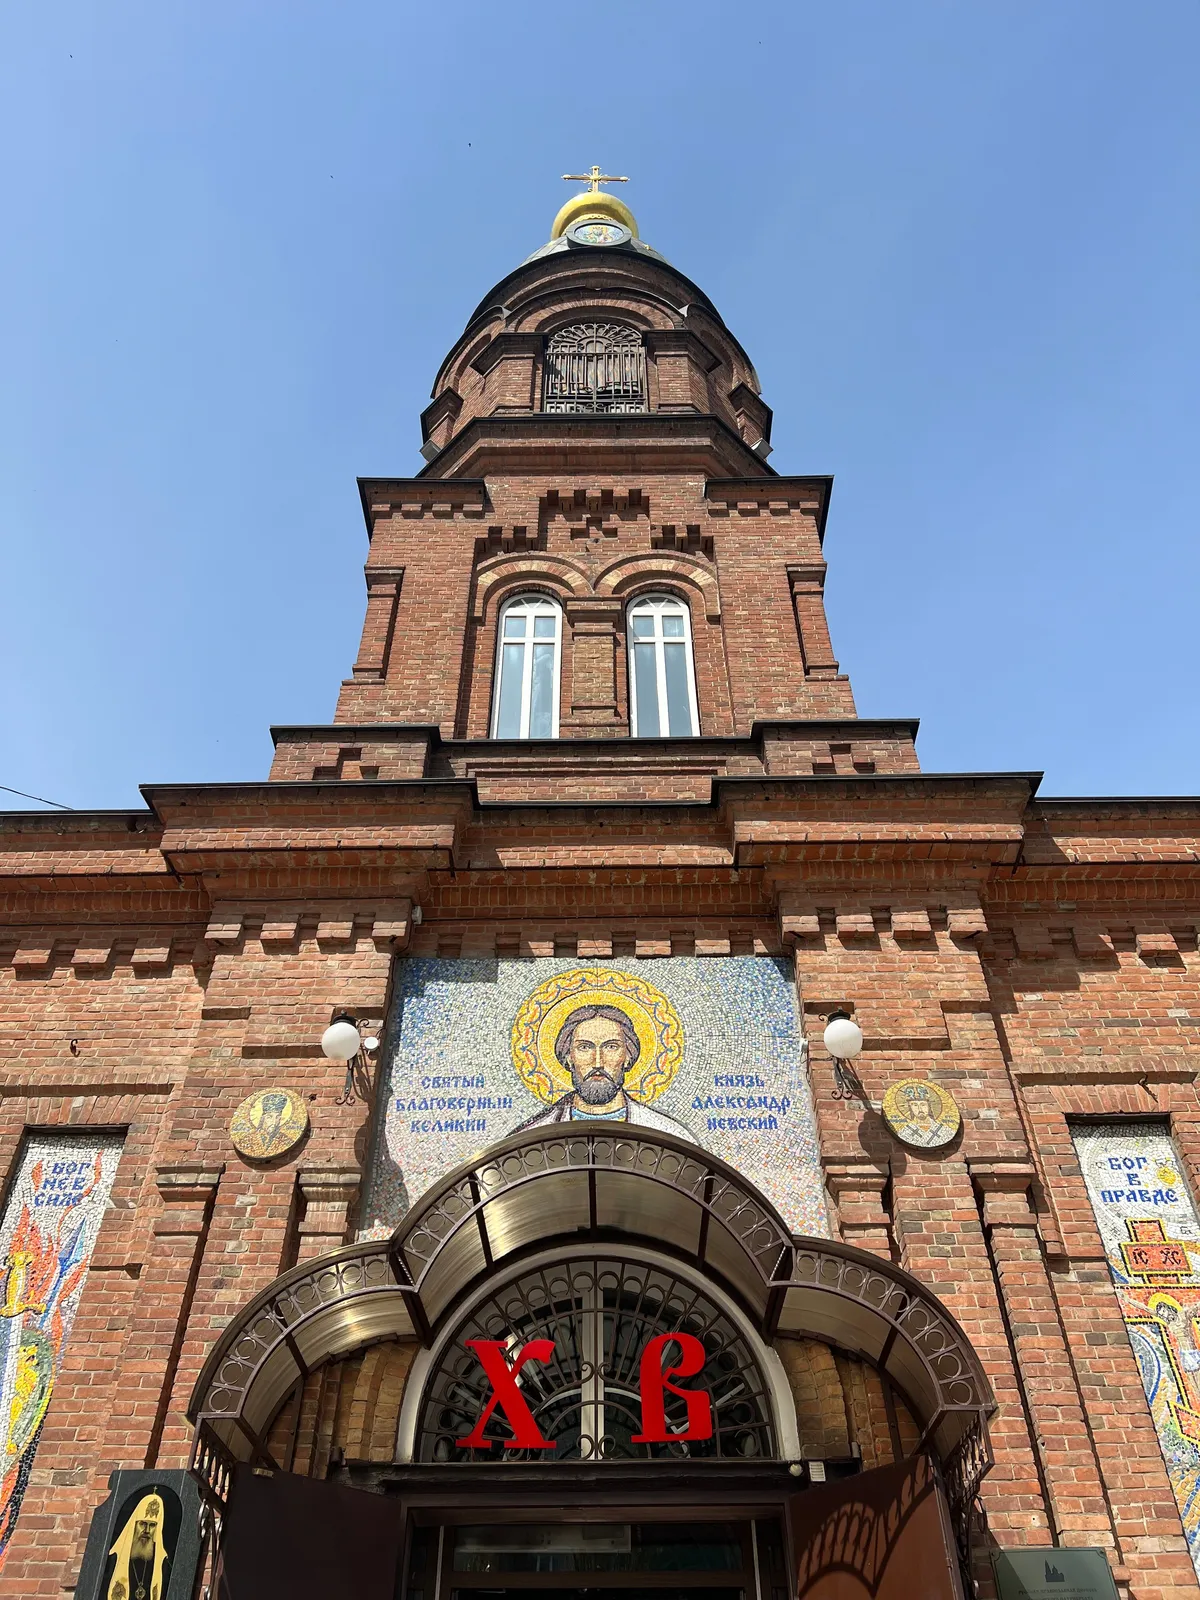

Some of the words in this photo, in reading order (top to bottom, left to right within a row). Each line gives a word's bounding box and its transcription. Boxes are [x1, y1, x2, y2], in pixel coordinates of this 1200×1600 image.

[421, 1073, 485, 1089] СВЯТЫЙ
[714, 1075, 764, 1088] КНЯЗЬ
[692, 1095, 791, 1115] АЛЕКСАНДР
[707, 1114, 778, 1130] НЕВСКИЙ
[52, 1161, 91, 1175] БОГ
[1108, 1157, 1147, 1170] БОГ
[72, 1177, 86, 1190] В
[1127, 1173, 1141, 1185] В
[1101, 1188, 1178, 1205] ПРАВДЕ
